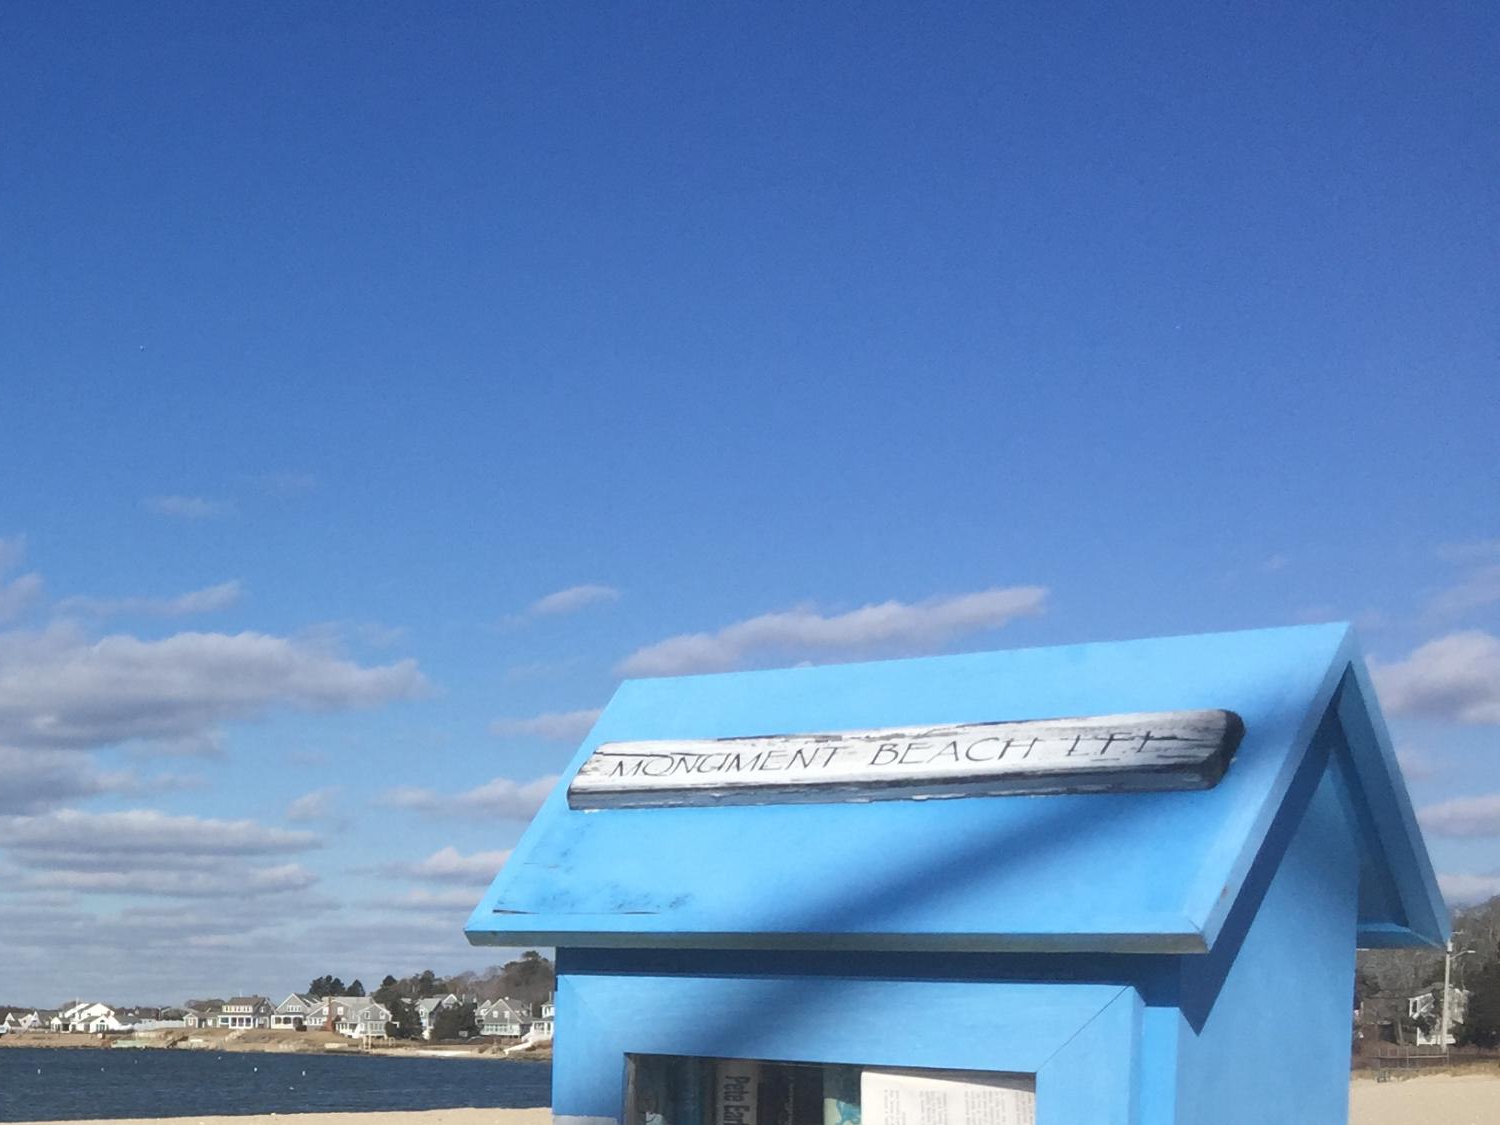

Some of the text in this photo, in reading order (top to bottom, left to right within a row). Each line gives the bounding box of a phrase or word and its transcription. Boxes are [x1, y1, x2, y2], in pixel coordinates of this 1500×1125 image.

[609, 746, 850, 778] MONUMENT
[868, 737, 1039, 766] BEACH
[723, 1075, 751, 1102] Pete
